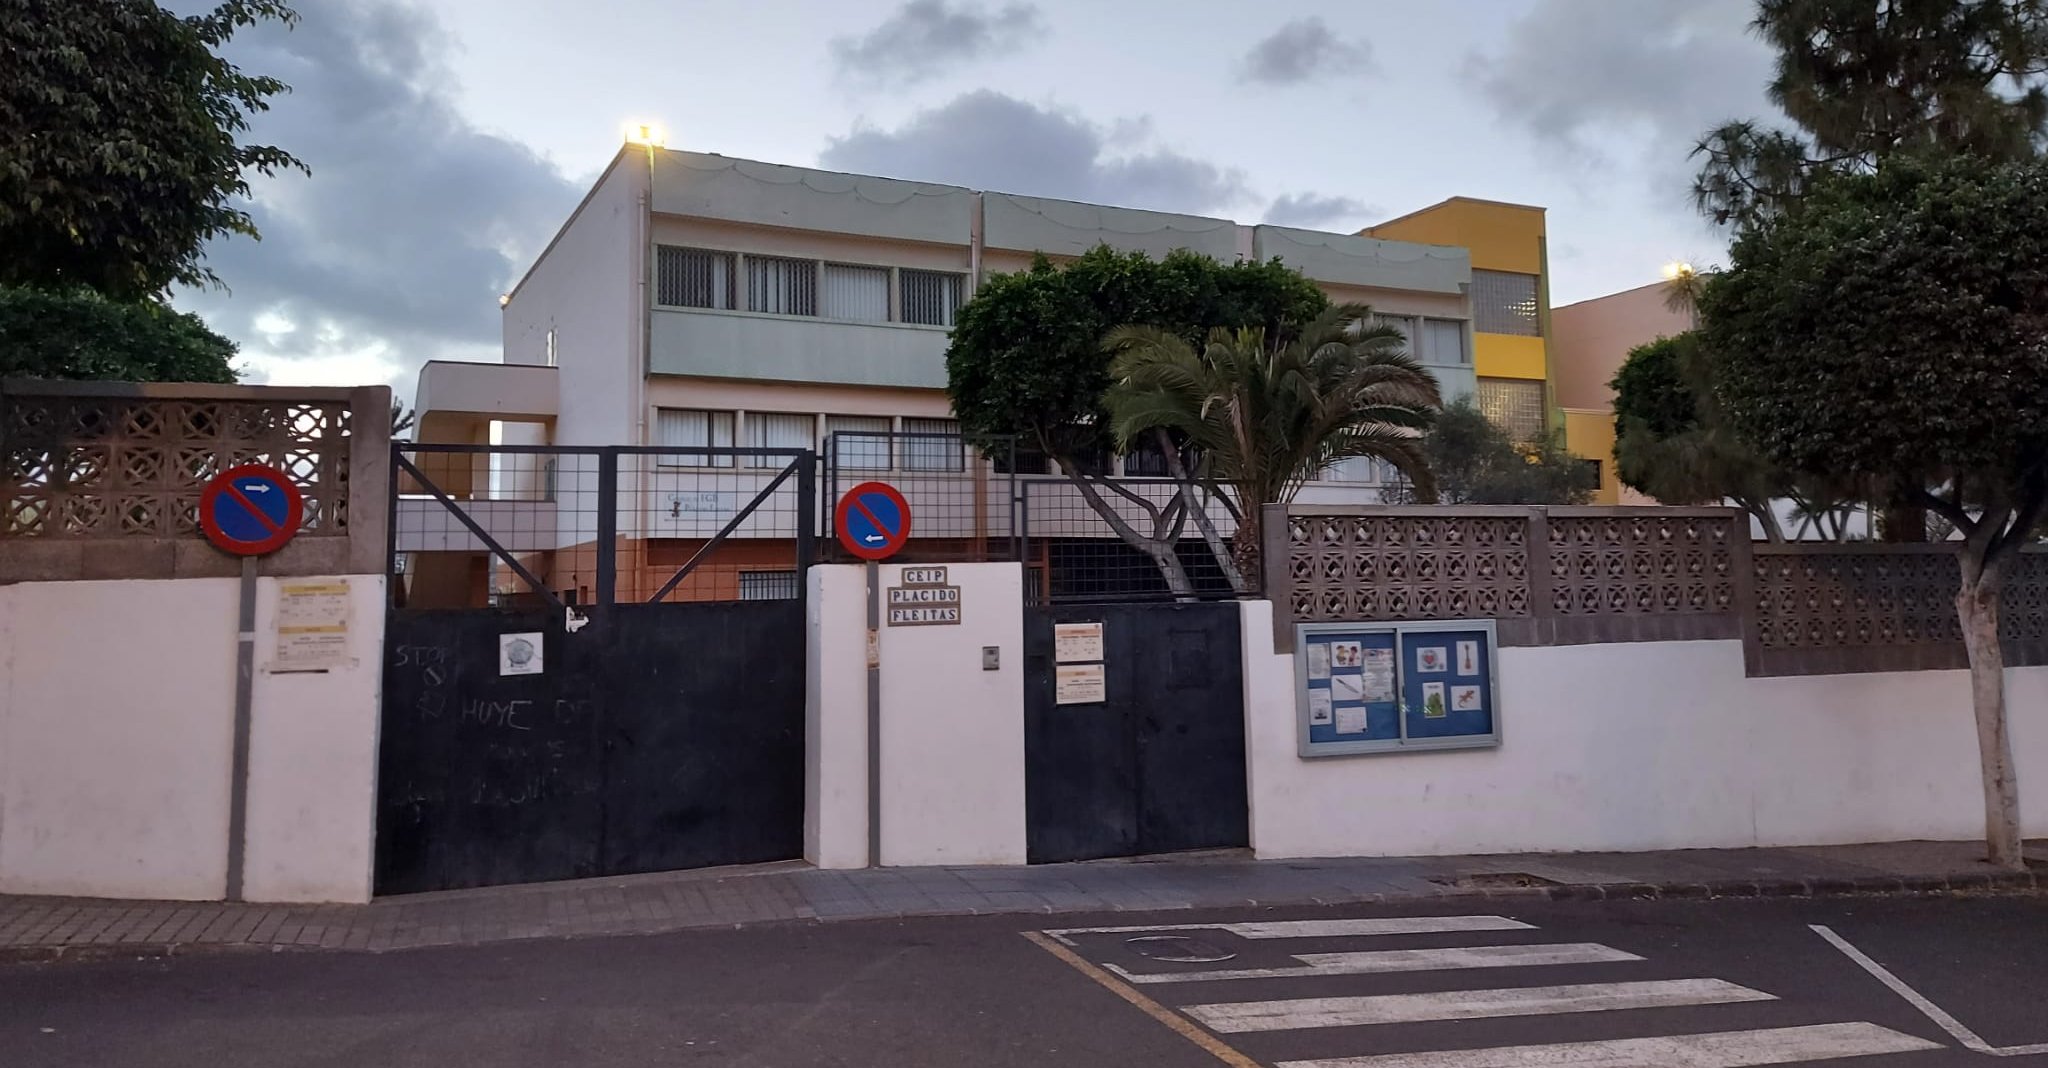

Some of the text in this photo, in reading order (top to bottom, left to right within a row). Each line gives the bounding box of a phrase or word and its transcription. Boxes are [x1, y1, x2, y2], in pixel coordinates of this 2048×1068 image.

[906, 570, 942, 582] CEIP
[893, 590, 957, 602] PLACIDO
[893, 609, 957, 621] FLEITAS
[461, 698, 533, 730] HUYE
